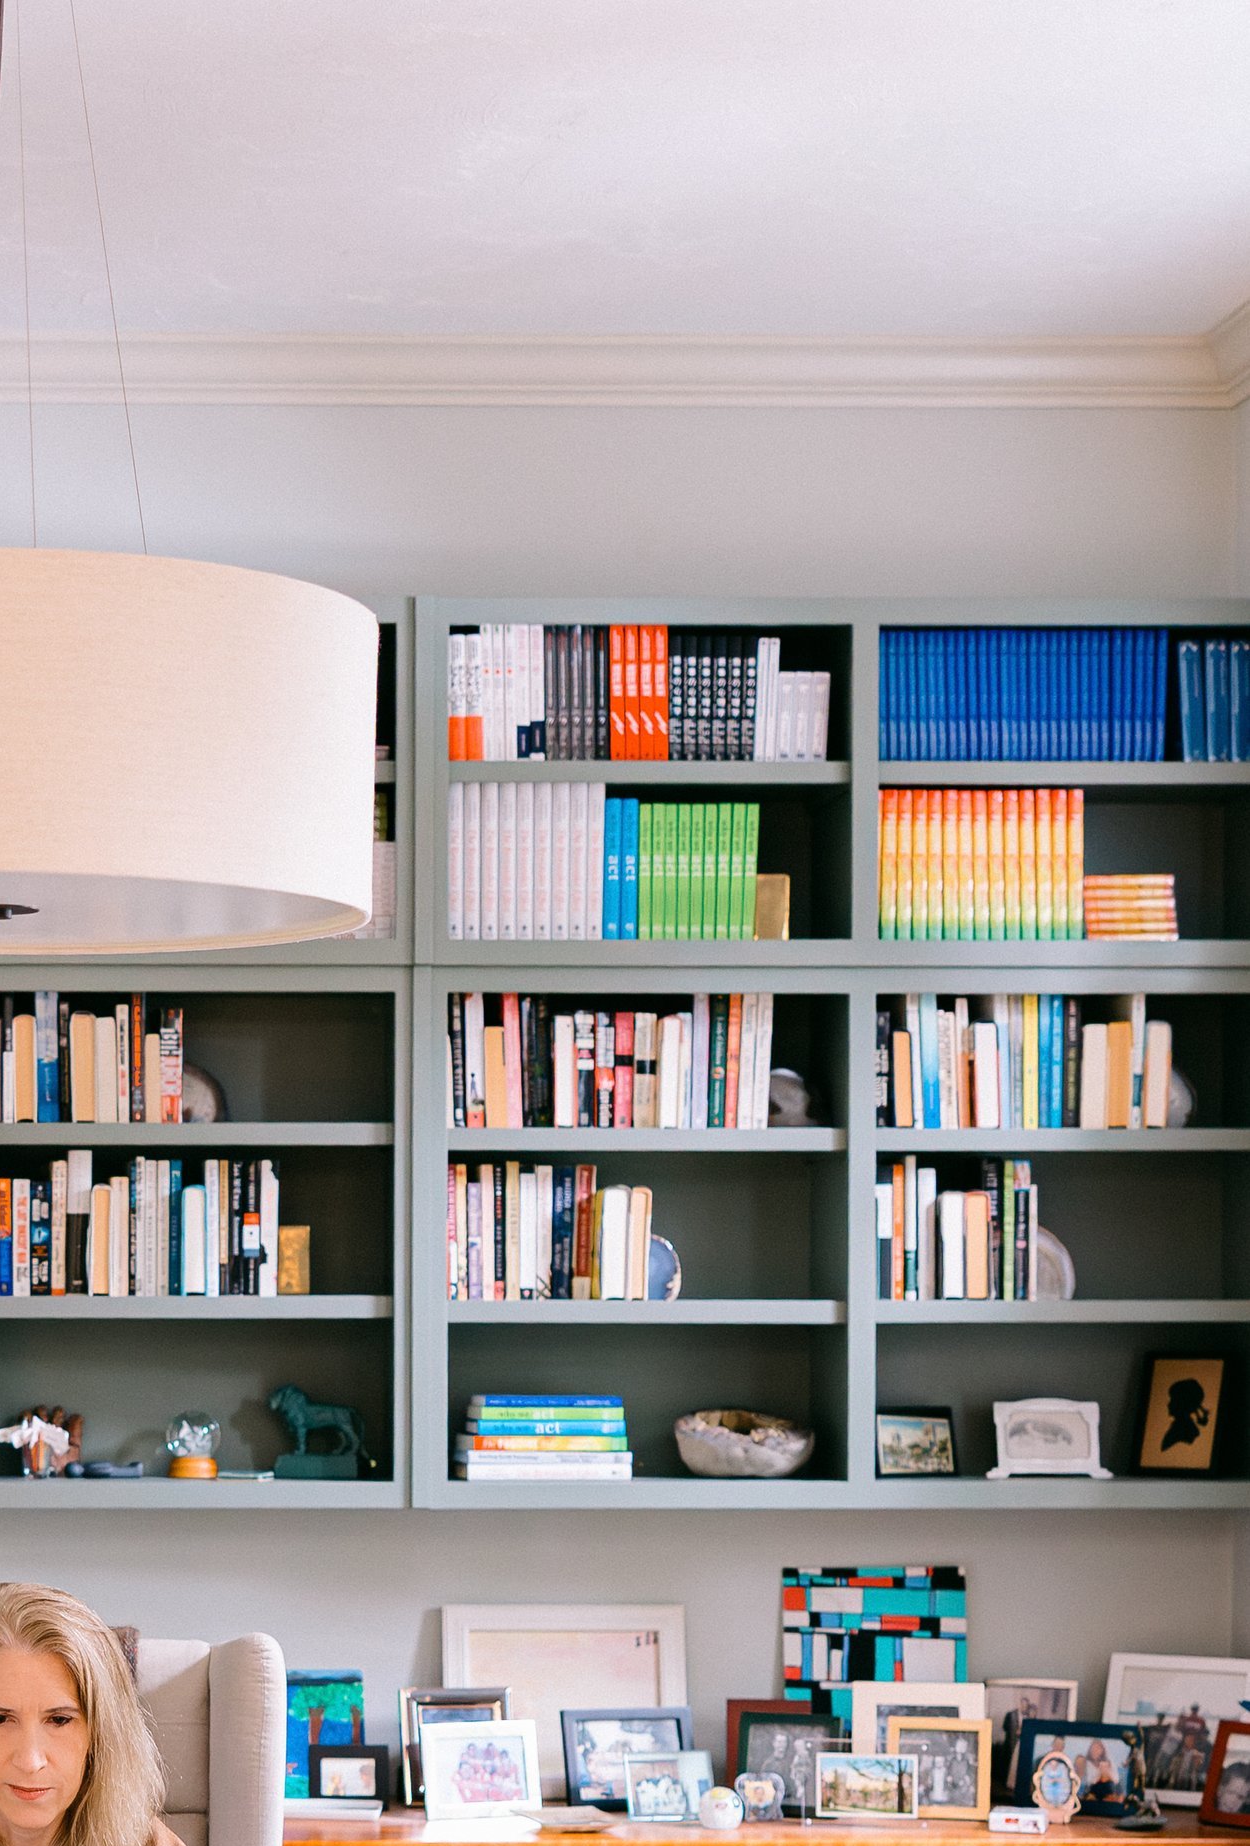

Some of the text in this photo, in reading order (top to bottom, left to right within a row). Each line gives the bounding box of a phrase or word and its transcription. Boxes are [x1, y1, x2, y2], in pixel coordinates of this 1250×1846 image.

[608, 855, 619, 881] act
[625, 855, 636, 882] act
[535, 1422, 561, 1434] act
